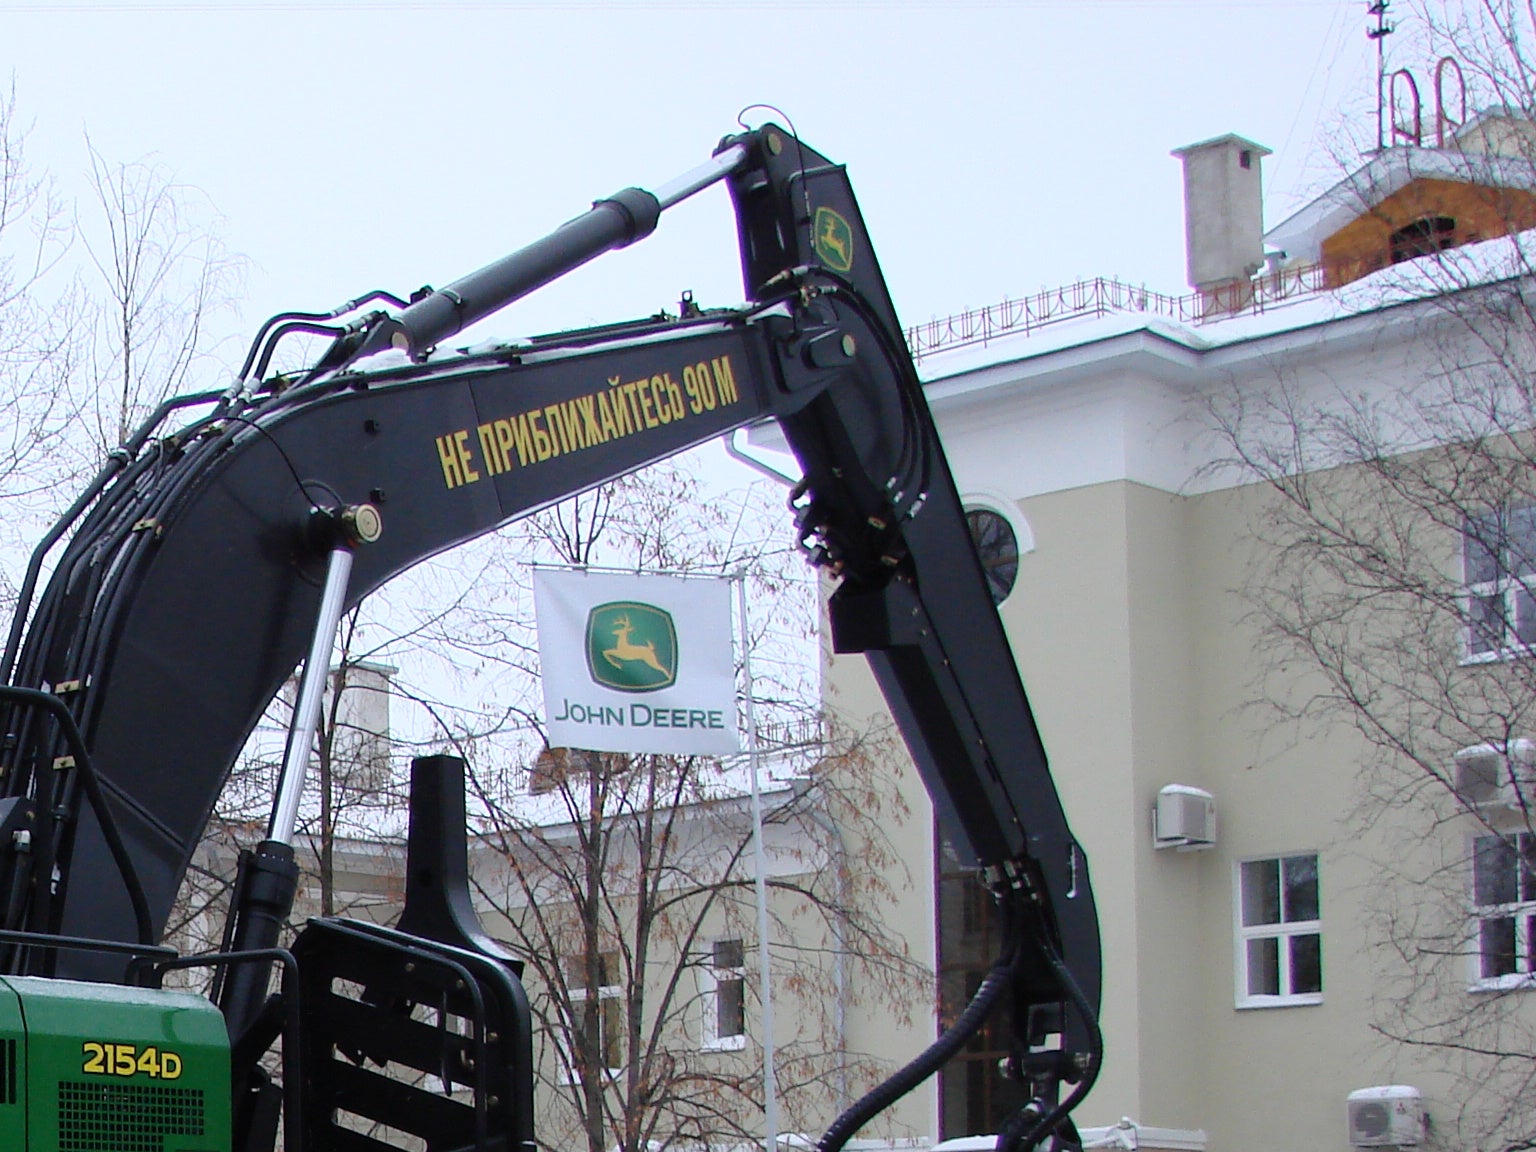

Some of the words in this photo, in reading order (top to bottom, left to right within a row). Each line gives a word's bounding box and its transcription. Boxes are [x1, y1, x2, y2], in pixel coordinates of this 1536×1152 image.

[435, 430, 479, 490] НЕ
[477, 374, 685, 477] ПРИБЛИЖАЙТЕСЬ
[683, 363, 718, 416] 90
[712, 355, 739, 407] М
[630, 703, 725, 729] DEERE
[82, 1041, 183, 1079] 2154D
